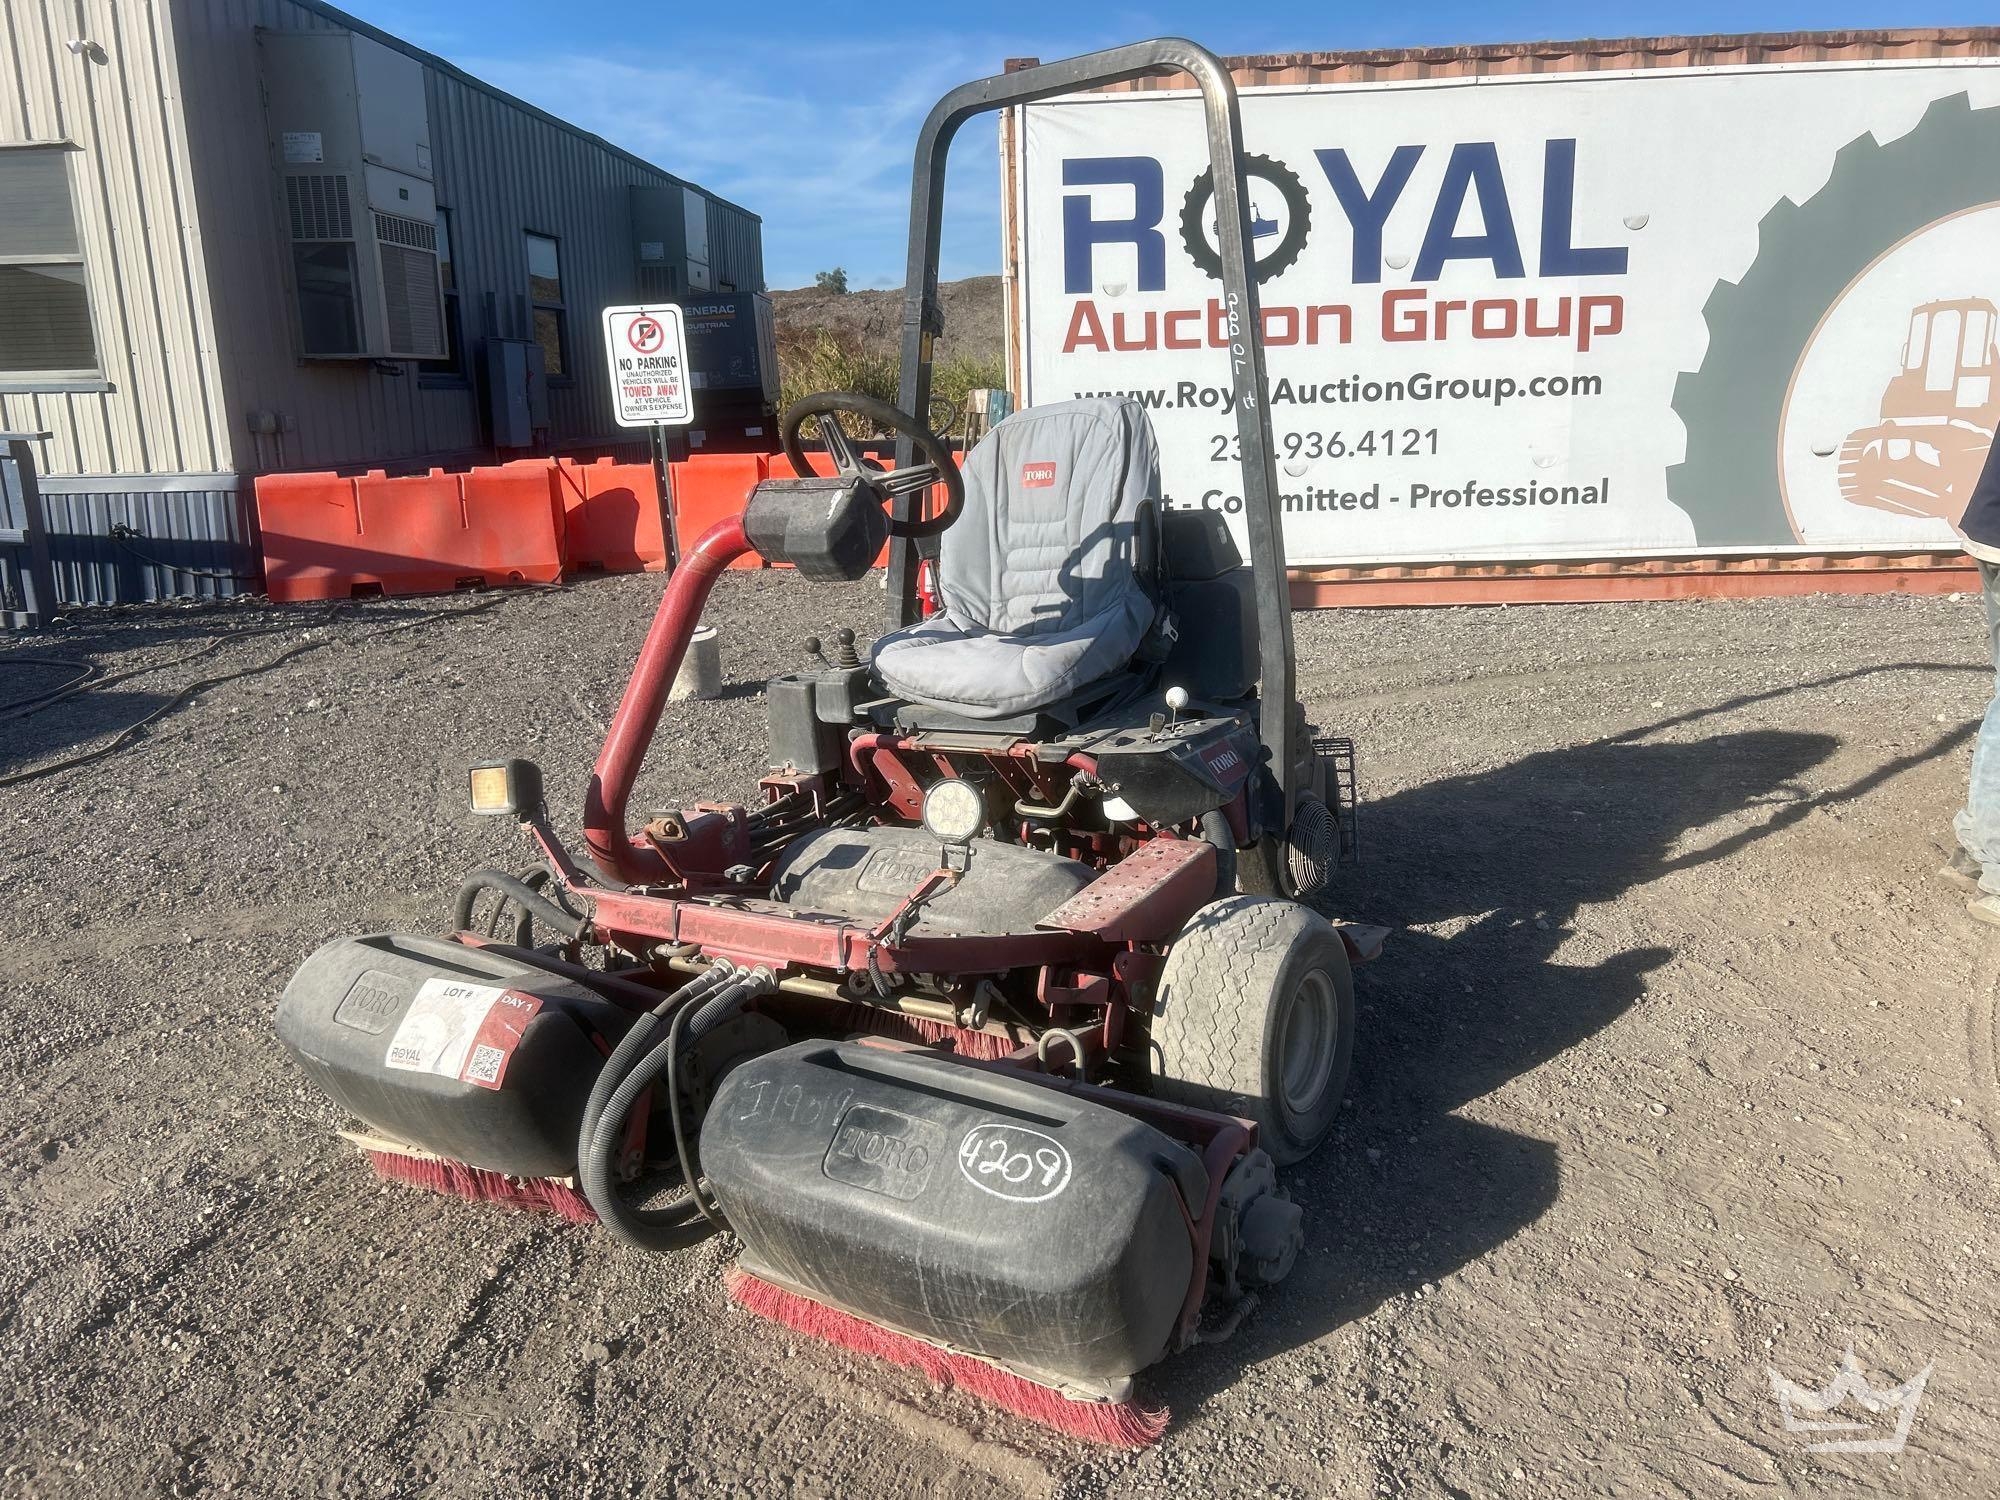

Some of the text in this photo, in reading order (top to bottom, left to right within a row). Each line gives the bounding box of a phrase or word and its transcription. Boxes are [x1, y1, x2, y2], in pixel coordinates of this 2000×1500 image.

[1062, 138, 1630, 295] ROYAL
[683, 304, 736, 316] ENERAC
[686, 321, 730, 330] DUSTRIAL
[1062, 288, 1624, 354] Aucton Group
[686, 328, 712, 336] OWER
[619, 356, 677, 371] NO PARKING
[622, 376, 679, 385] VEHICLES WILL BE
[626, 369, 672, 378] UNAUTHORIZED
[623, 384, 678, 398] TOWED AWAY
[1075, 371, 1602, 414] w.RoyAuctionGroup.com
[1210, 427, 1440, 462] 23.936.4121
[1025, 469, 1053, 481] TORO
[1202, 484, 1379, 514] Comitted
[1410, 478, 1609, 509] Professional
[1208, 750, 1239, 774] TORO
[868, 857, 930, 885] TORO
[353, 984, 400, 1017] TORO
[443, 987, 465, 998] LOT
[501, 995, 533, 1012] DAY 1
[391, 1047, 421, 1061] ROYAL
[838, 1127, 929, 1175] TORO
[961, 1132, 1061, 1187] 4209
